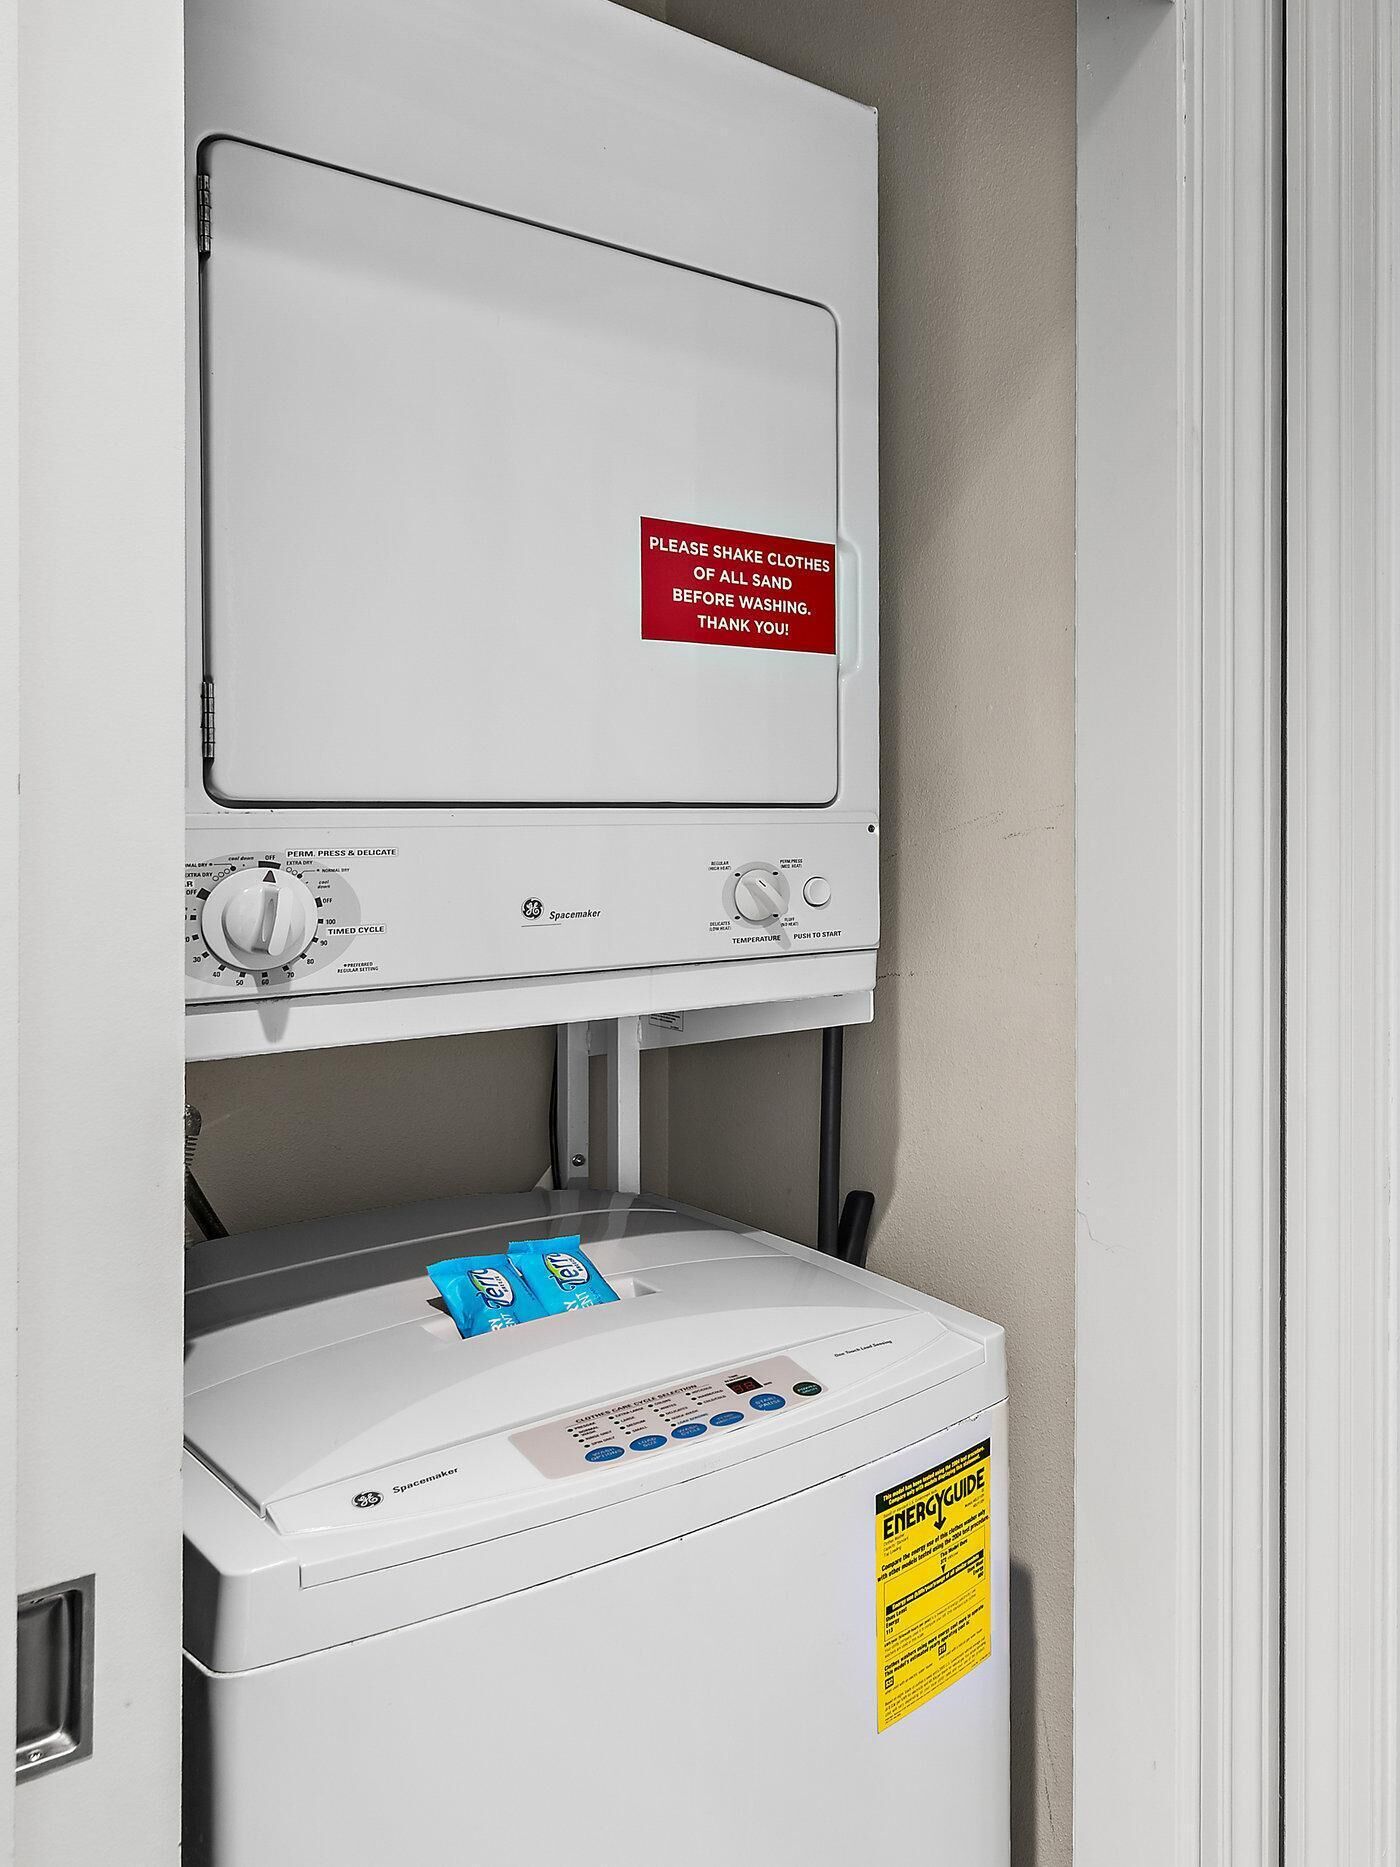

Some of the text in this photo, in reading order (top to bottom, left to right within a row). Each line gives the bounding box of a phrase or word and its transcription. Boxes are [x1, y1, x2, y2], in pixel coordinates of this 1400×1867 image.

[649, 536, 830, 573] PLEASE SHAKE CLOTHES
[693, 566, 793, 590] OF ALL SAND
[672, 588, 811, 615] BEFORE WASHING.
[697, 615, 789, 636] THANK YOU!
[317, 849, 346, 857] PRESS
[549, 909, 601, 921] Spacemaker
[328, 926, 385, 935] TIMED CYCLE
[732, 935, 781, 944] TEMPERATURE
[793, 932, 812, 940] PUSH
[822, 930, 842, 938] START
[576, 1385, 697, 1423] CLOTHES CARE CYCLE SELECTION
[392, 1468, 458, 1494] Spacemaker
[882, 1493, 891, 1502] This
[883, 1467, 985, 1540] ENERGYGUIDE
[888, 1492, 906, 1505] Compare
[881, 1509, 985, 1571] Compare the energy use of this clothes washer only
[877, 1572, 887, 1582] with
[888, 1566, 900, 1577] other
[901, 1557, 917, 1570] models
[917, 1548, 931, 1560] tested
[932, 1543, 943, 1552] using
[951, 1530, 961, 1541] 2004
[885, 1617, 899, 1628] Energy
[884, 1659, 899, 1671] Clothes
[900, 1649, 916, 1662] washers
[927, 1635, 937, 1645] more
[937, 1627, 949, 1638] energy
[958, 1616, 966, 1624] more
[884, 1668, 893, 1677] This
[909, 1646, 928, 1663] estimated
